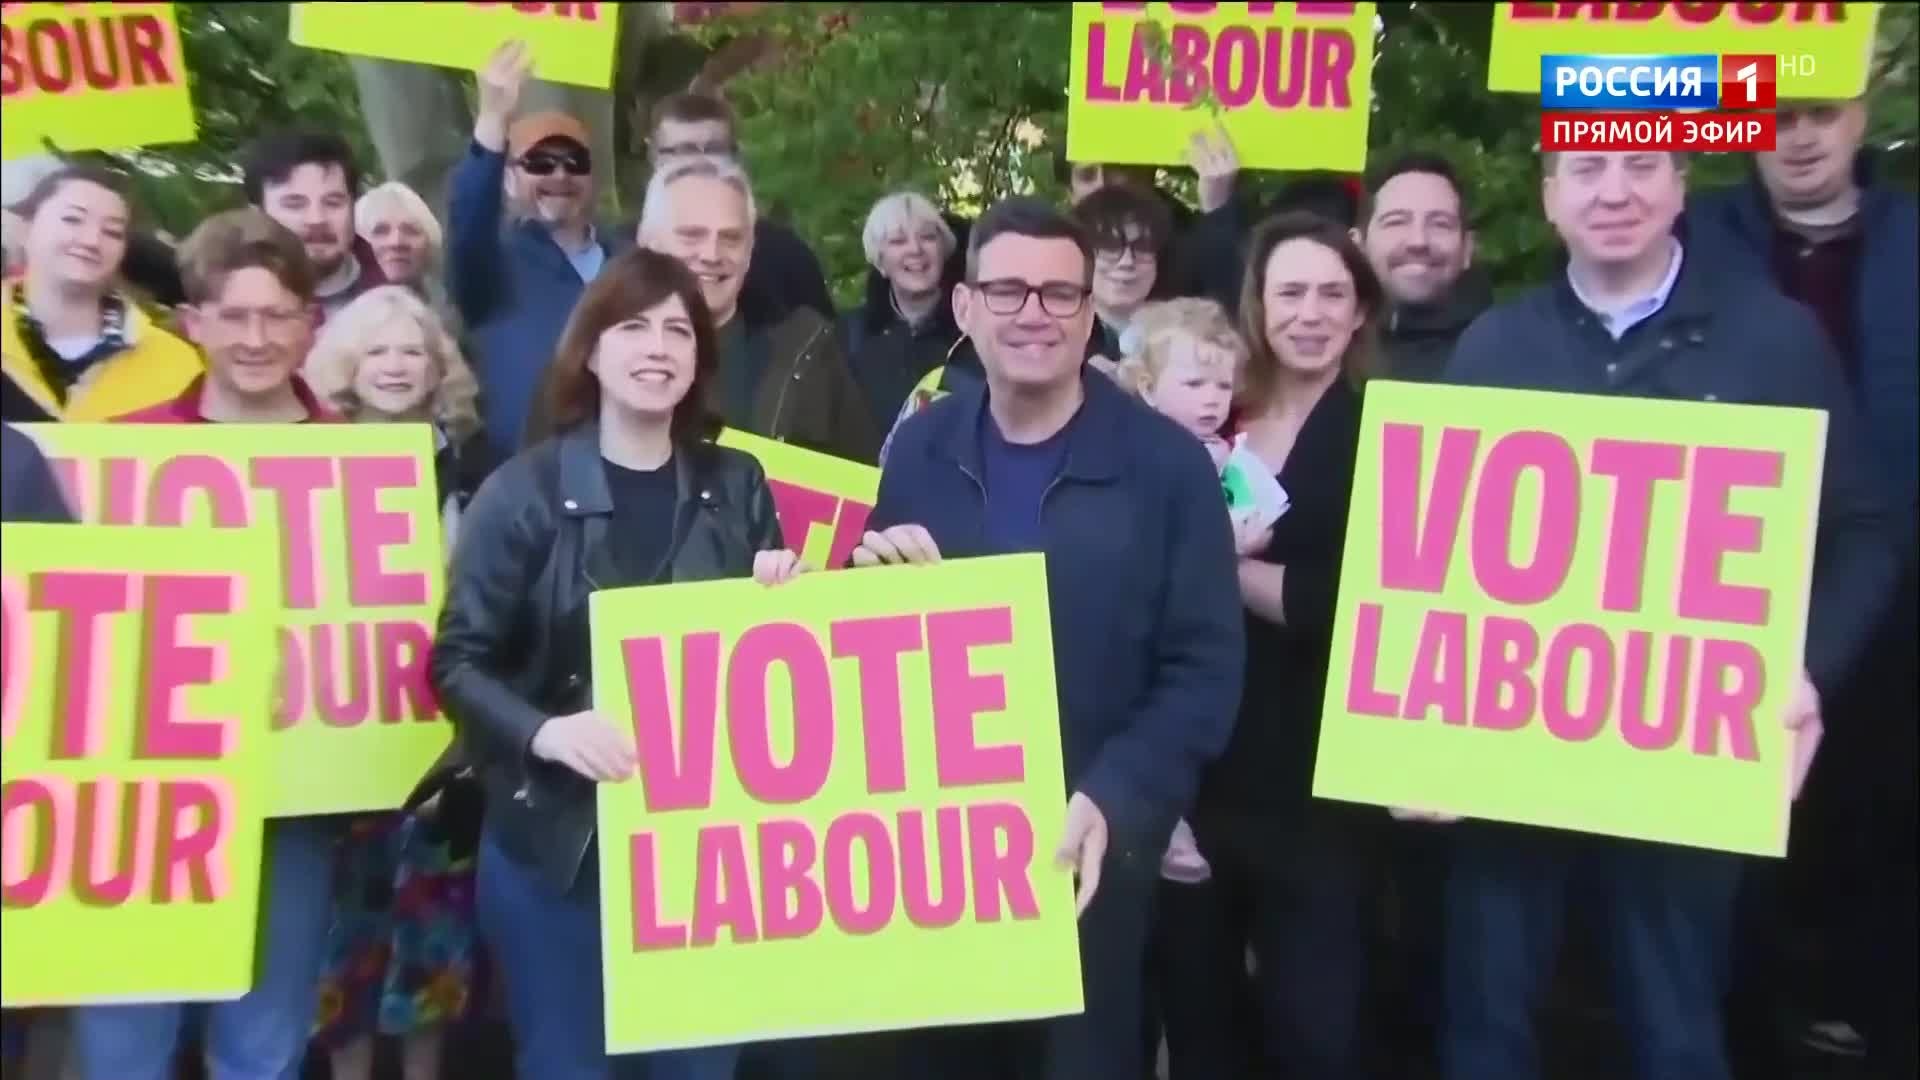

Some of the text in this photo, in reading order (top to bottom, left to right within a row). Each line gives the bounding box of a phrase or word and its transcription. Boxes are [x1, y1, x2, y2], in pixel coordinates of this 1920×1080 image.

[1086, 22, 1355, 109] LABOUR
[1380, 422, 1786, 626] VOTE
[1, 571, 234, 760] TE
[620, 606, 1025, 813] VOTE
[1346, 602, 1768, 762] LABOUR
[628, 803, 1041, 953] LABOUR
